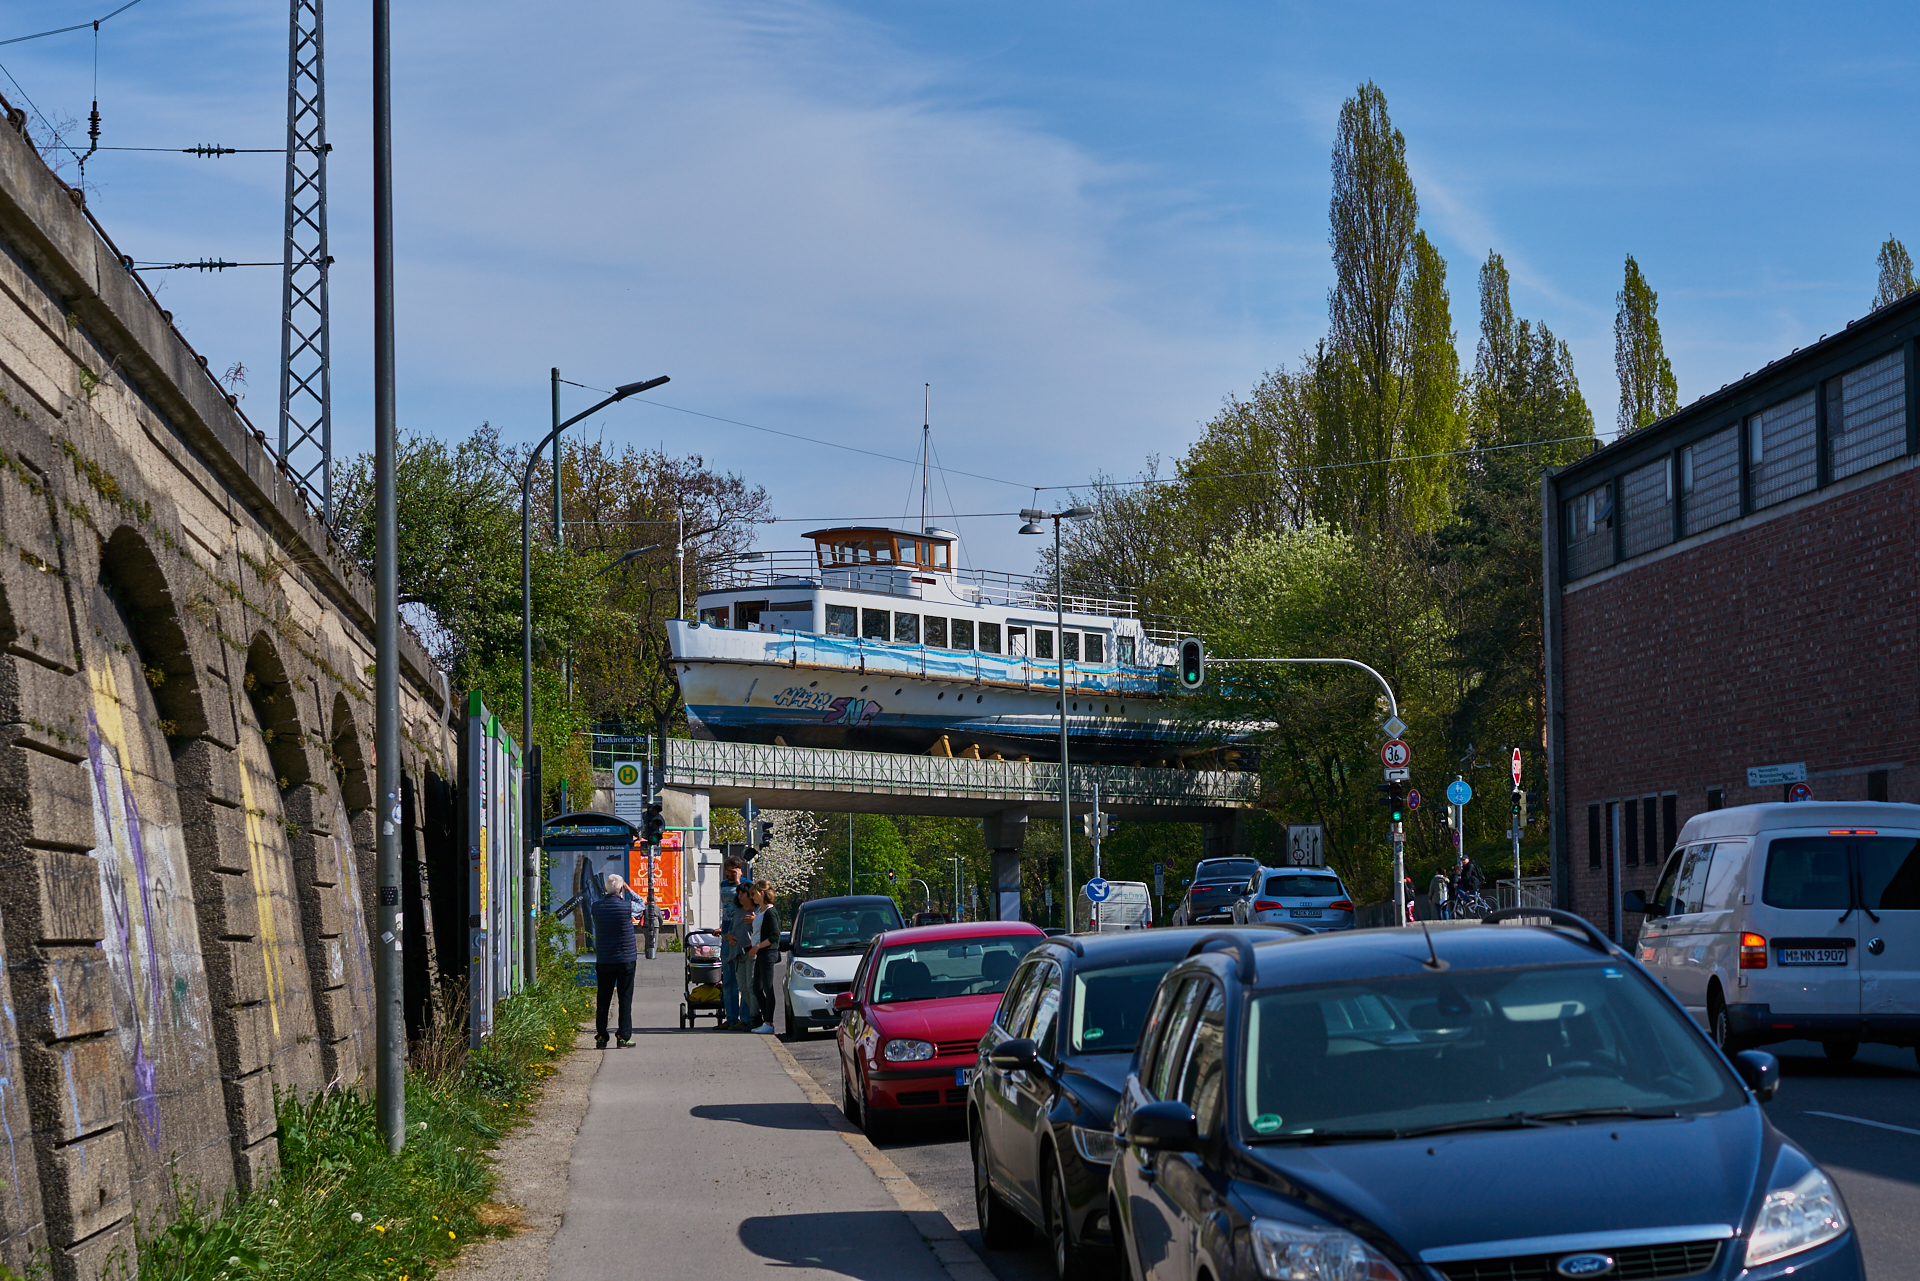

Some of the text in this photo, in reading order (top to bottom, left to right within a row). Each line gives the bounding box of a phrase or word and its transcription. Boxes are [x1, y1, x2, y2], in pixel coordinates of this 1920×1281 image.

[623, 769, 633, 781] H
[1785, 950, 1845, 961] M MN 1907
[1570, 1259, 1599, 1273] Ford
